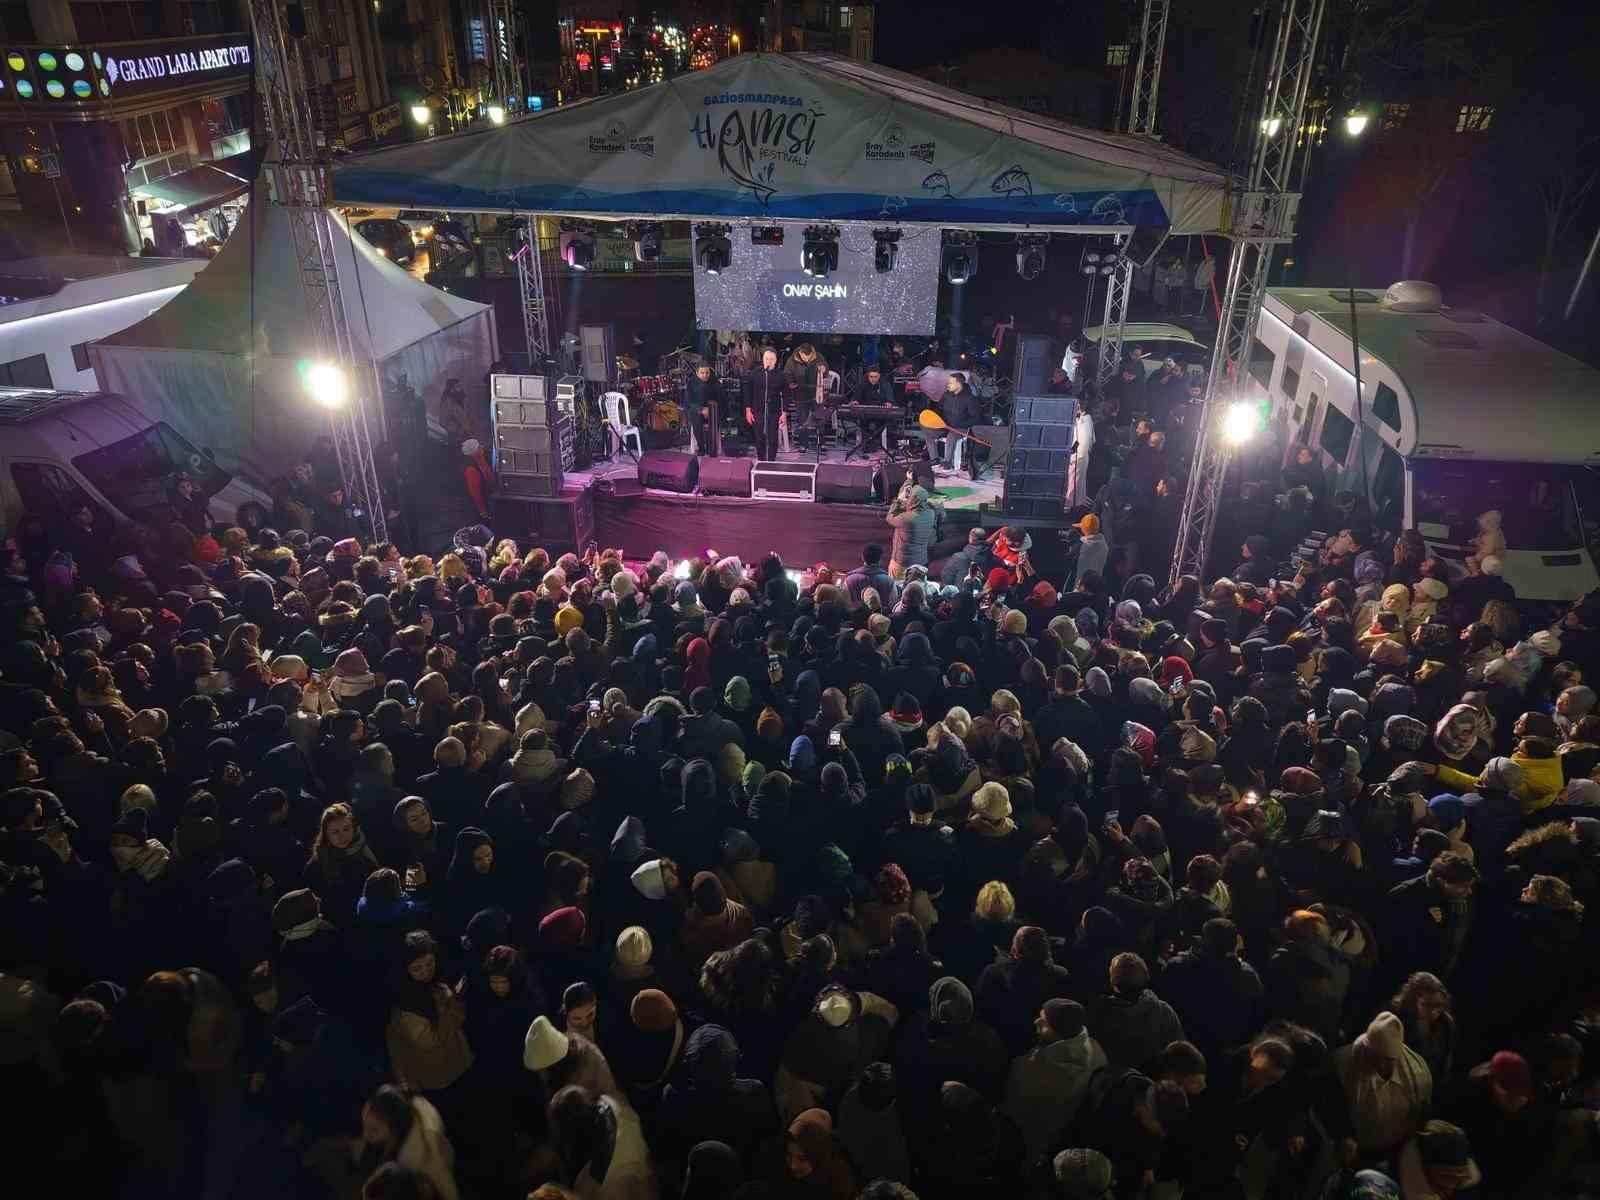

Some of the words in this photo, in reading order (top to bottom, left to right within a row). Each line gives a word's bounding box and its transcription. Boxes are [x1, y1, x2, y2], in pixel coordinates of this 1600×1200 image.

[119, 56, 165, 82] GRAND
[165, 51, 201, 75] LARA
[200, 48, 229, 71] APART
[783, 283, 813, 297] ONAY
[814, 281, 847, 300] ŞAHİN
